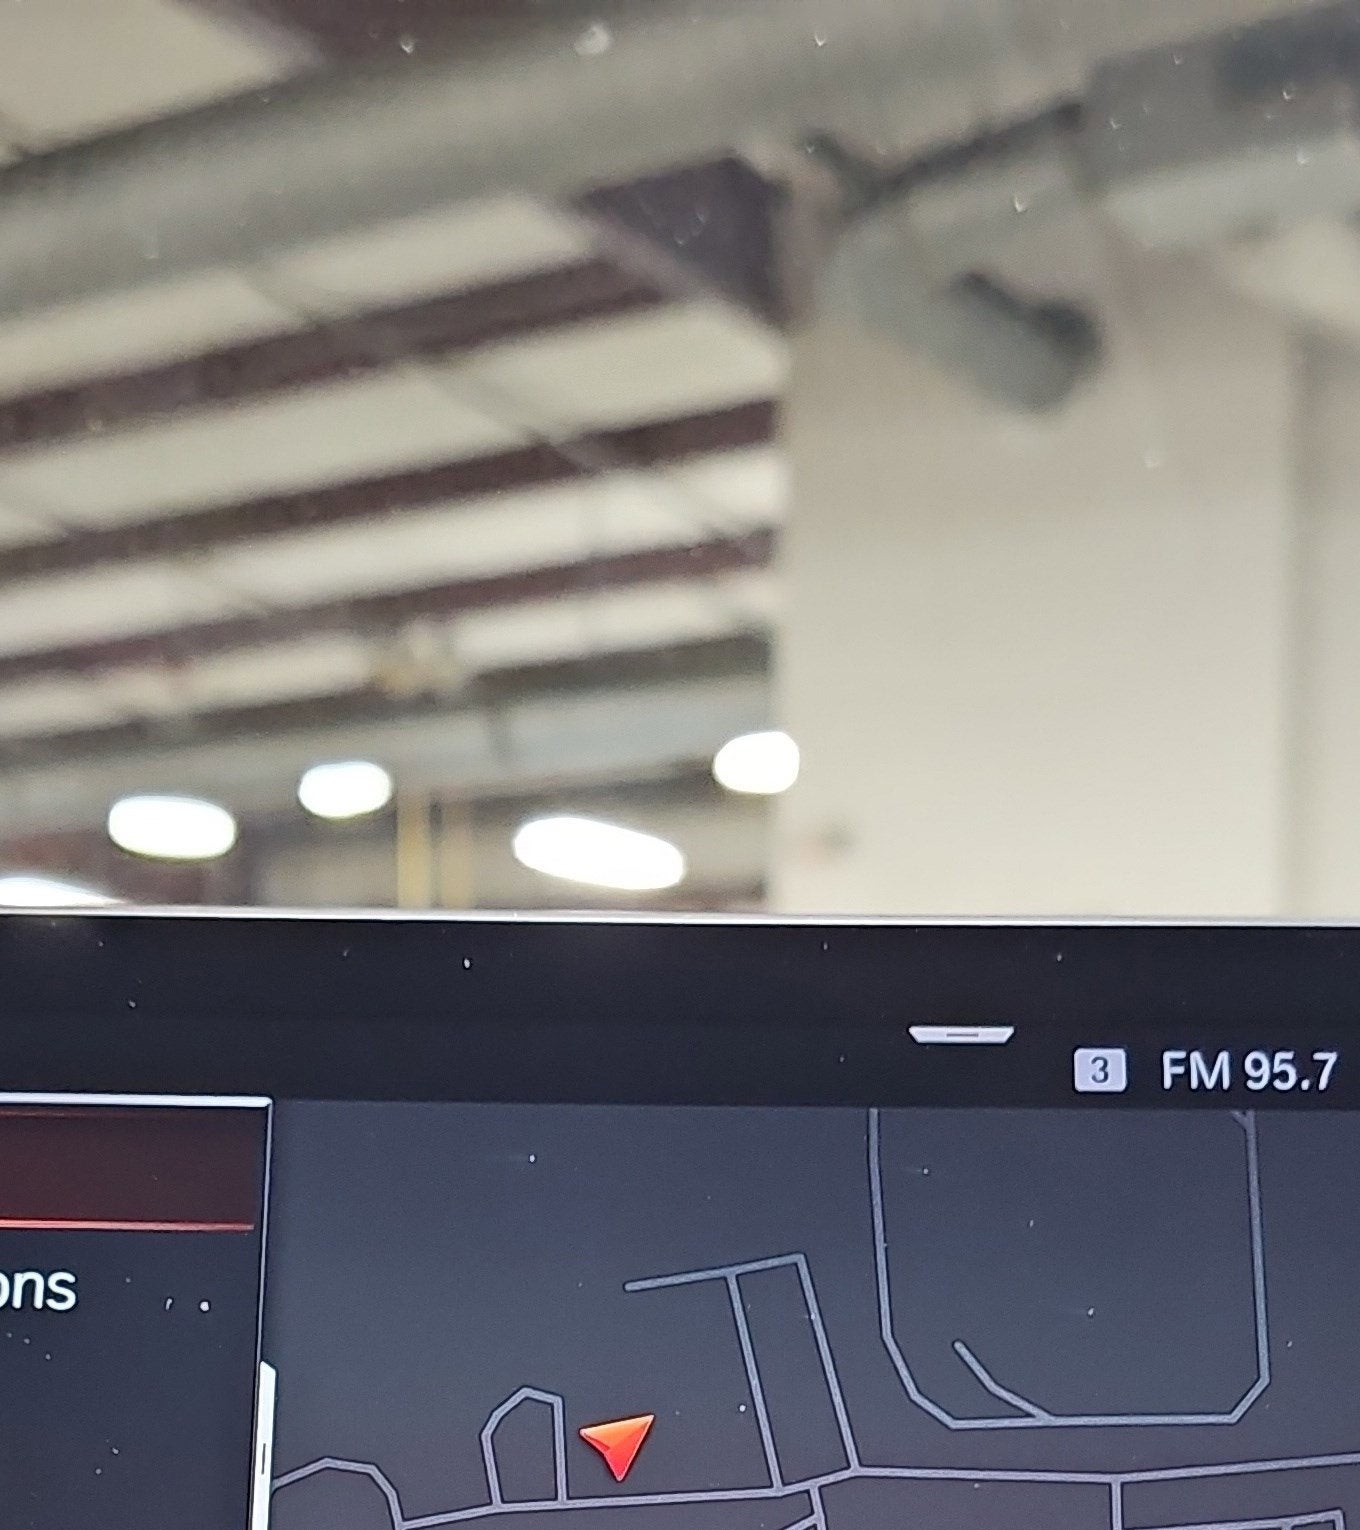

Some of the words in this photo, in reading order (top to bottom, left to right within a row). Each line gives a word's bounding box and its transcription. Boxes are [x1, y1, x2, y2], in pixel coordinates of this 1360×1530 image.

[1090, 1056, 1110, 1086] 3
[1161, 1051, 1230, 1090] FM
[1244, 1052, 1338, 1091] 95.7
